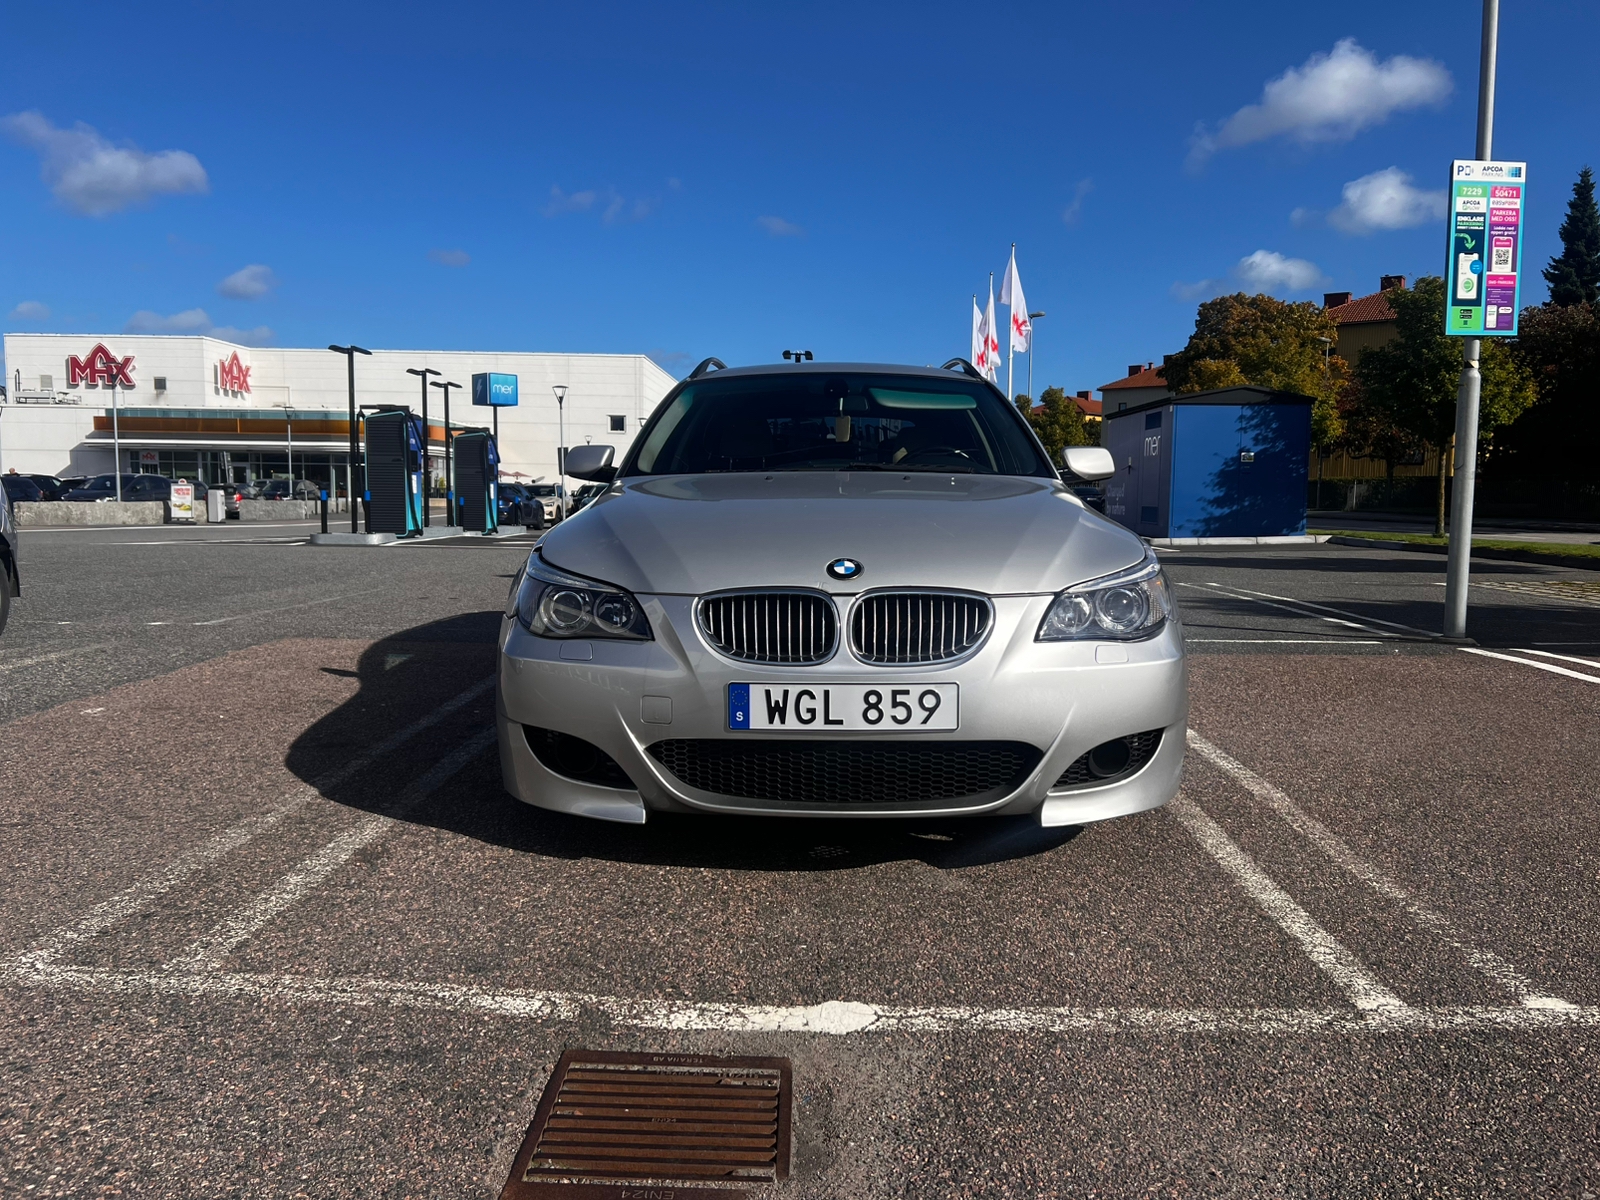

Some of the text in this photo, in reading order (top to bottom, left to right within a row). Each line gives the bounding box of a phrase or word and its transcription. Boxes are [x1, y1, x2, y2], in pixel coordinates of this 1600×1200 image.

[68, 342, 136, 386] MAX
[219, 350, 252, 394] MAX
[492, 383, 514, 395] mer
[1144, 436, 1160, 456] mer
[735, 711, 744, 722] S
[764, 689, 942, 725] WGL 859
